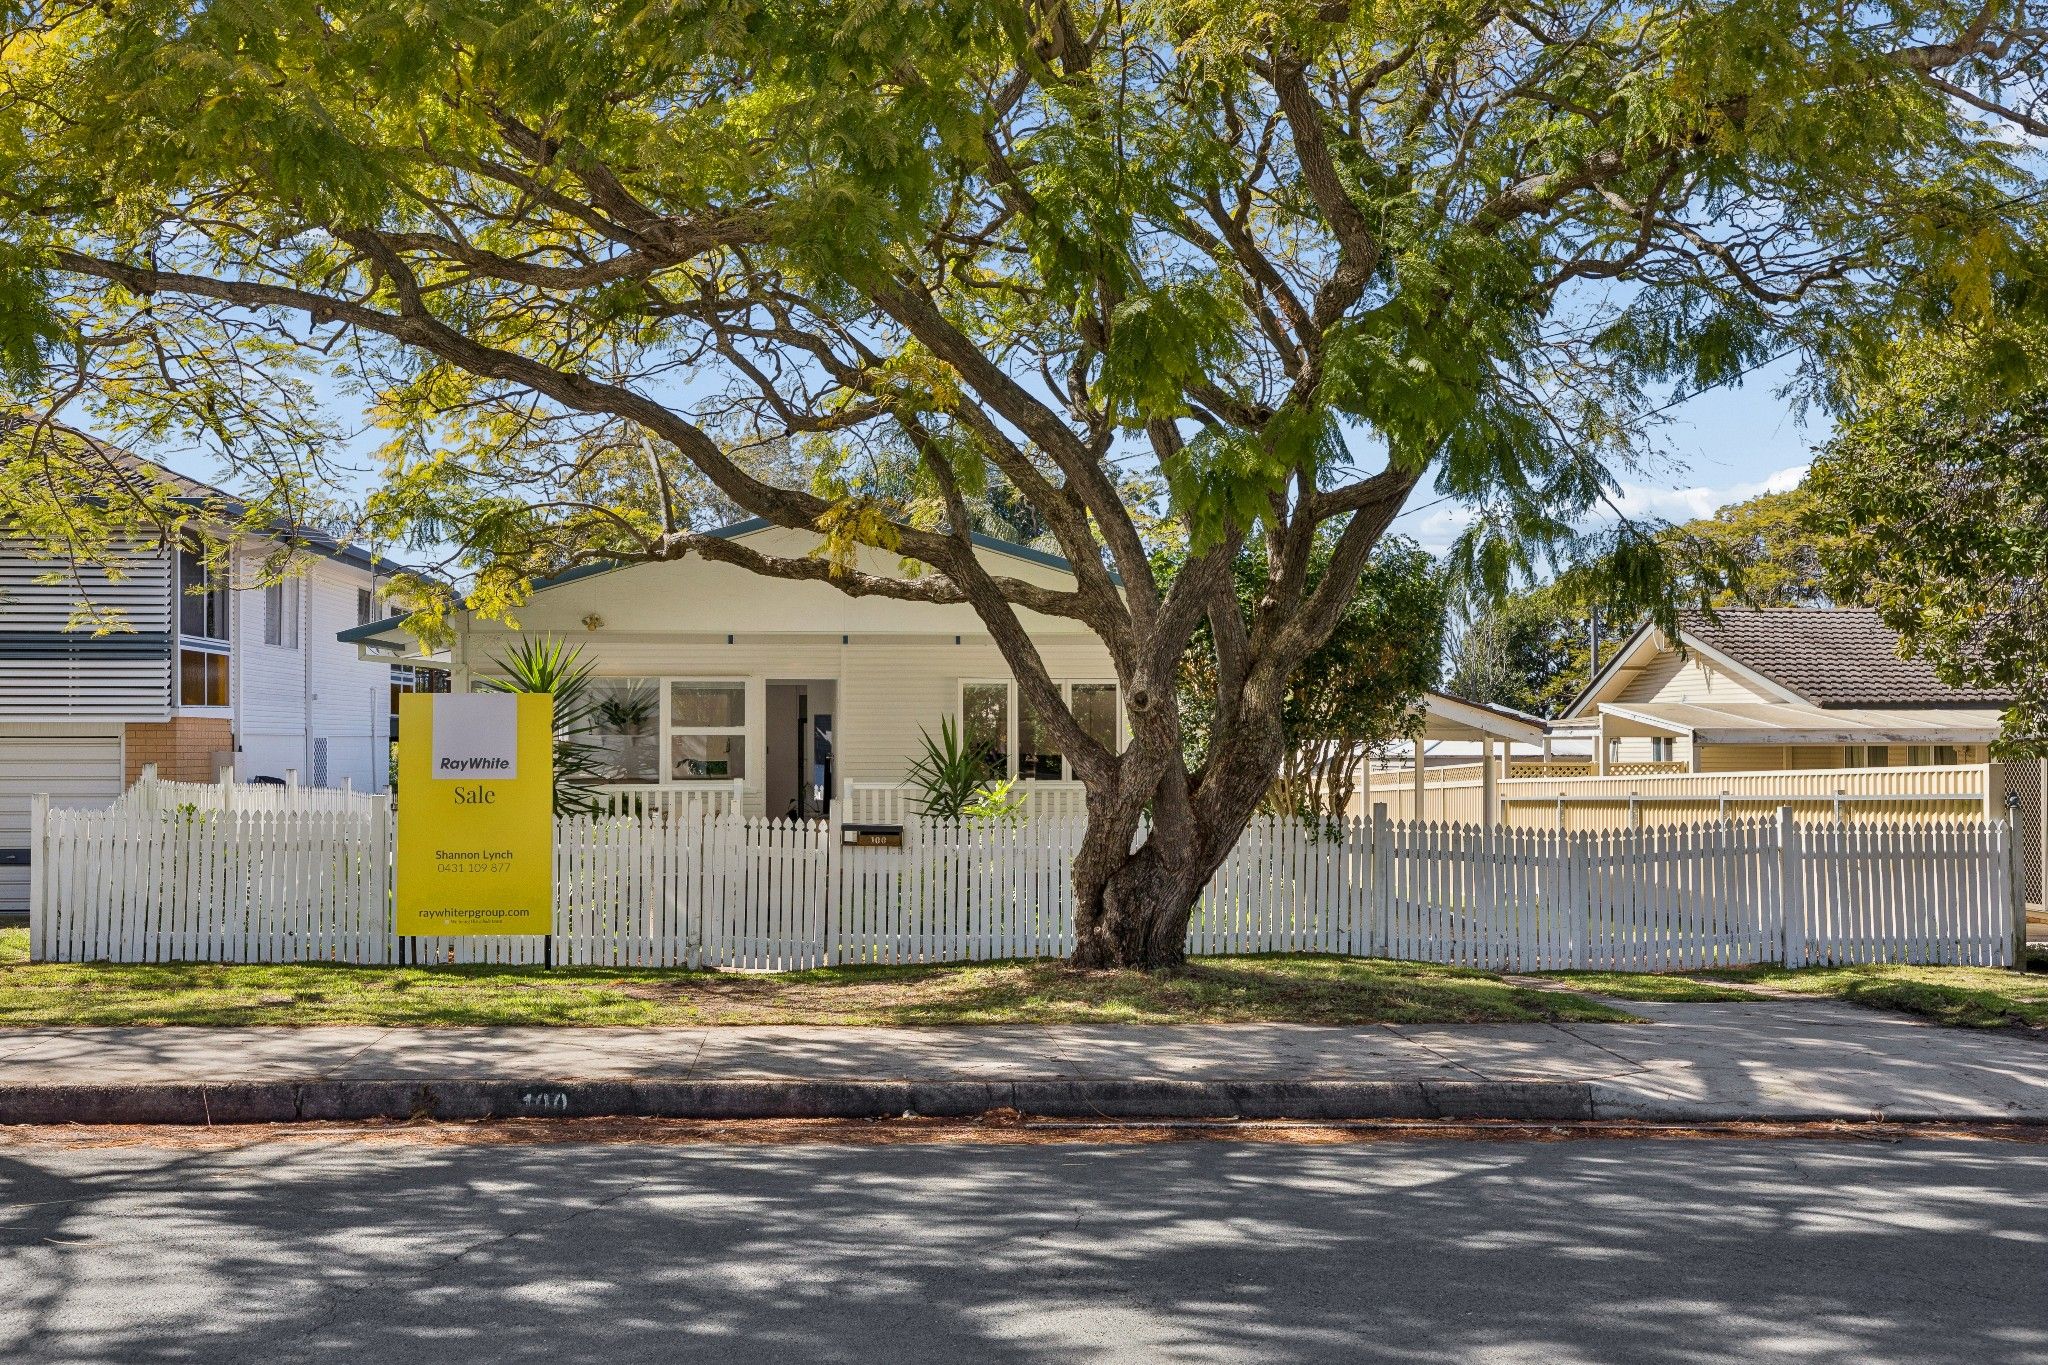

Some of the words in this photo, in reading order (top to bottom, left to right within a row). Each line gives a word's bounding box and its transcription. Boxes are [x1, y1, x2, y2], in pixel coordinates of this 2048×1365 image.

[454, 784, 496, 805] Sale
[435, 850, 480, 860] Shannon
[483, 850, 513, 862] Lynch
[437, 863, 464, 873] 0431
[468, 863, 488, 873] 109
[490, 863, 511, 873] 877
[419, 908, 530, 919] raywhiterpgroup.com
